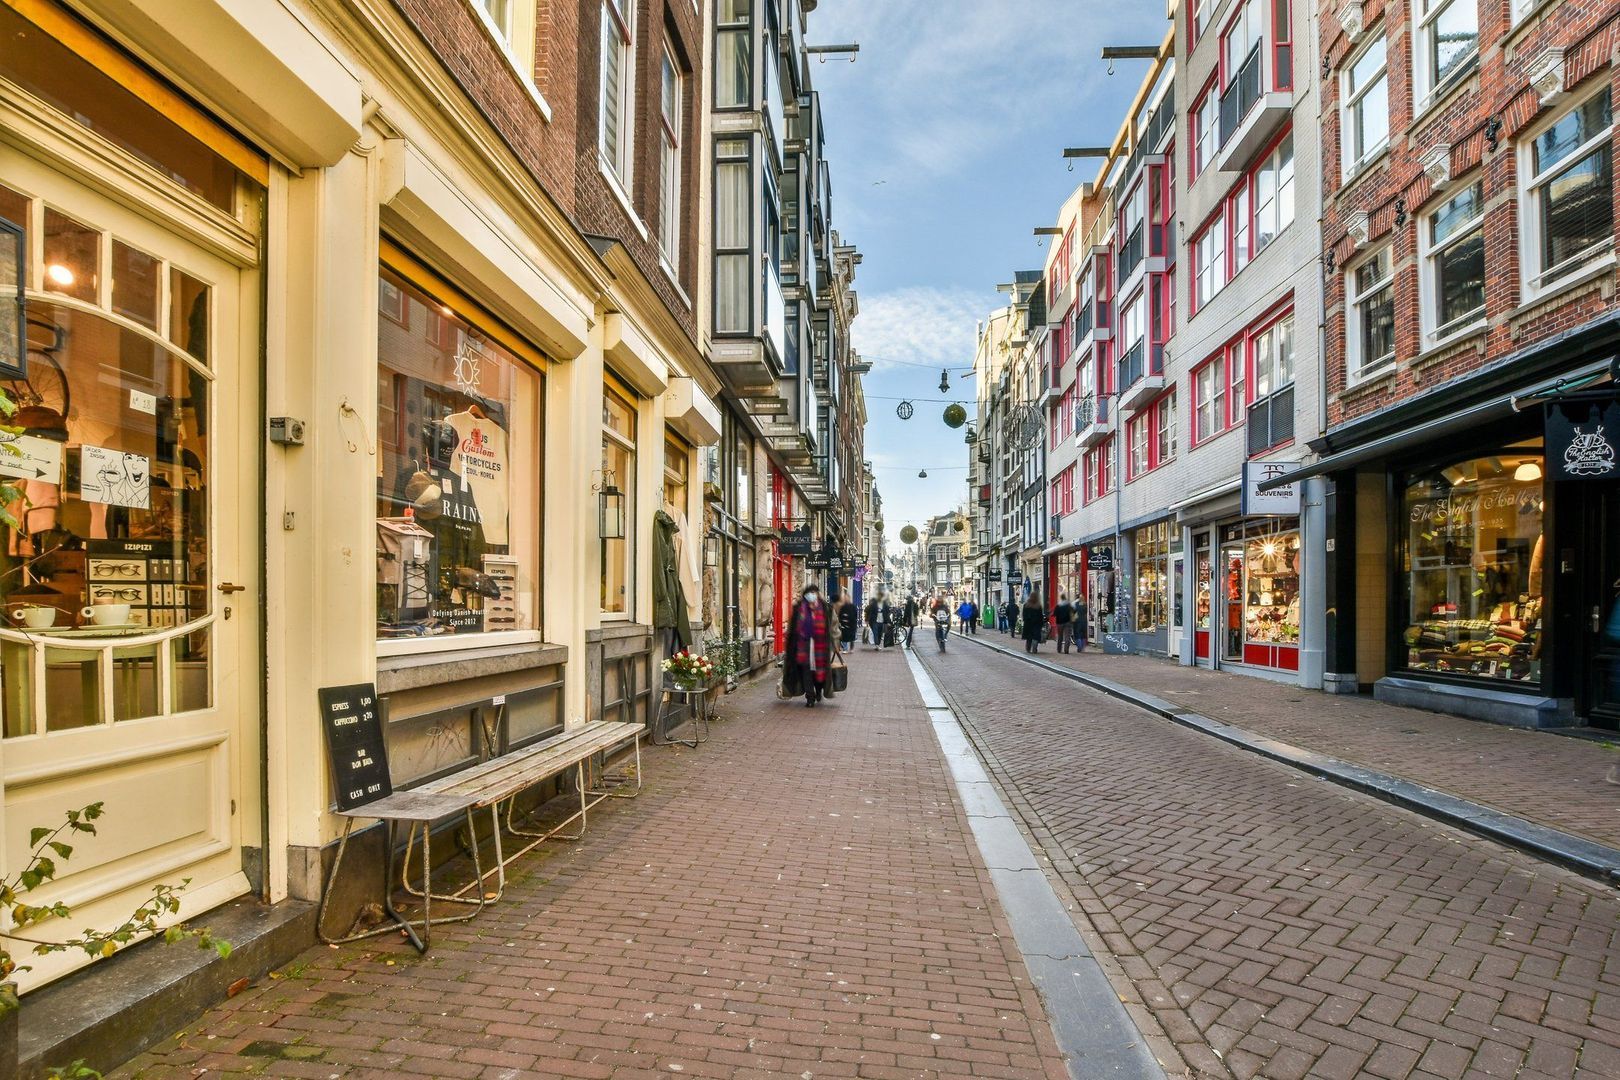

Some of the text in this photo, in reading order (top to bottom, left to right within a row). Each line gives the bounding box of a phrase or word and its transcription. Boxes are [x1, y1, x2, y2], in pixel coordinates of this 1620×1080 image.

[461, 438, 495, 458] Custom
[458, 453, 501, 472] MTORCYCLES
[124, 543, 153, 551] IZIPIZI
[449, 618, 463, 626] Since
